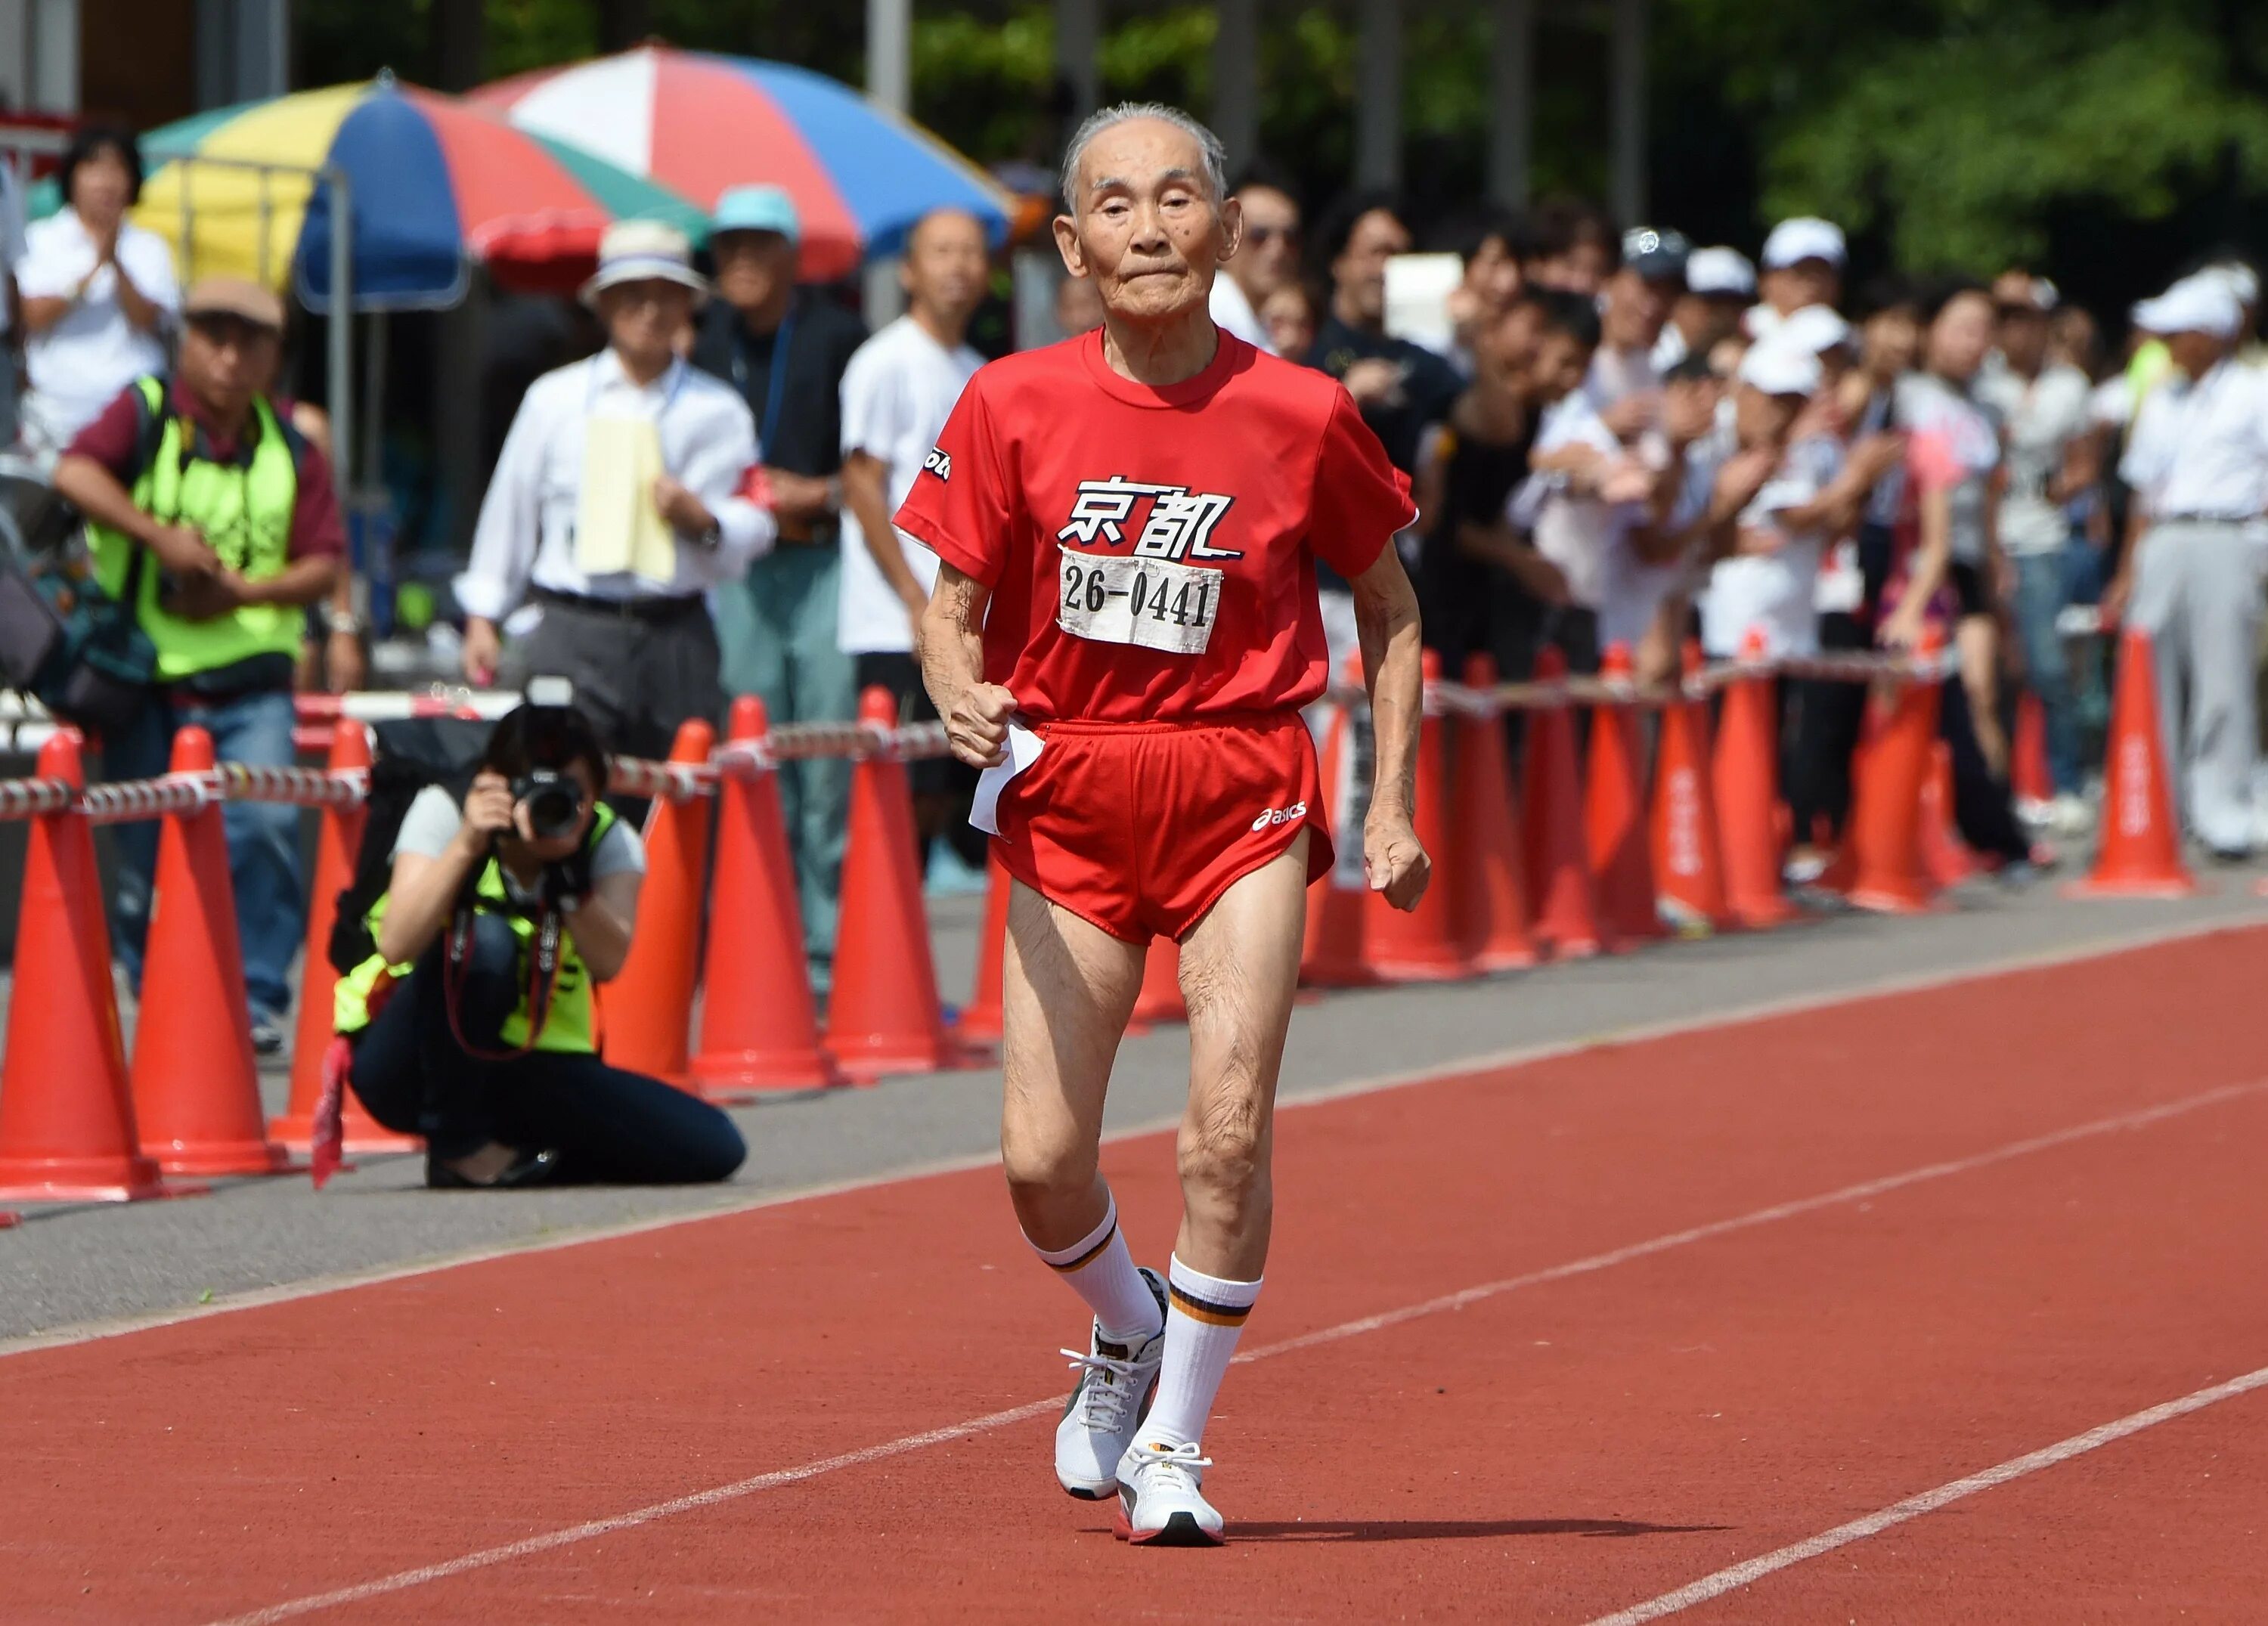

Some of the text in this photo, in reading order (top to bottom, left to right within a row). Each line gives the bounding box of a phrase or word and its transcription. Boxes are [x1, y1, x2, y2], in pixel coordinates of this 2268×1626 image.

[1057, 475, 1244, 560] 京都
[1065, 565, 1210, 627] 26-0441
[1271, 801, 1307, 825] asics
